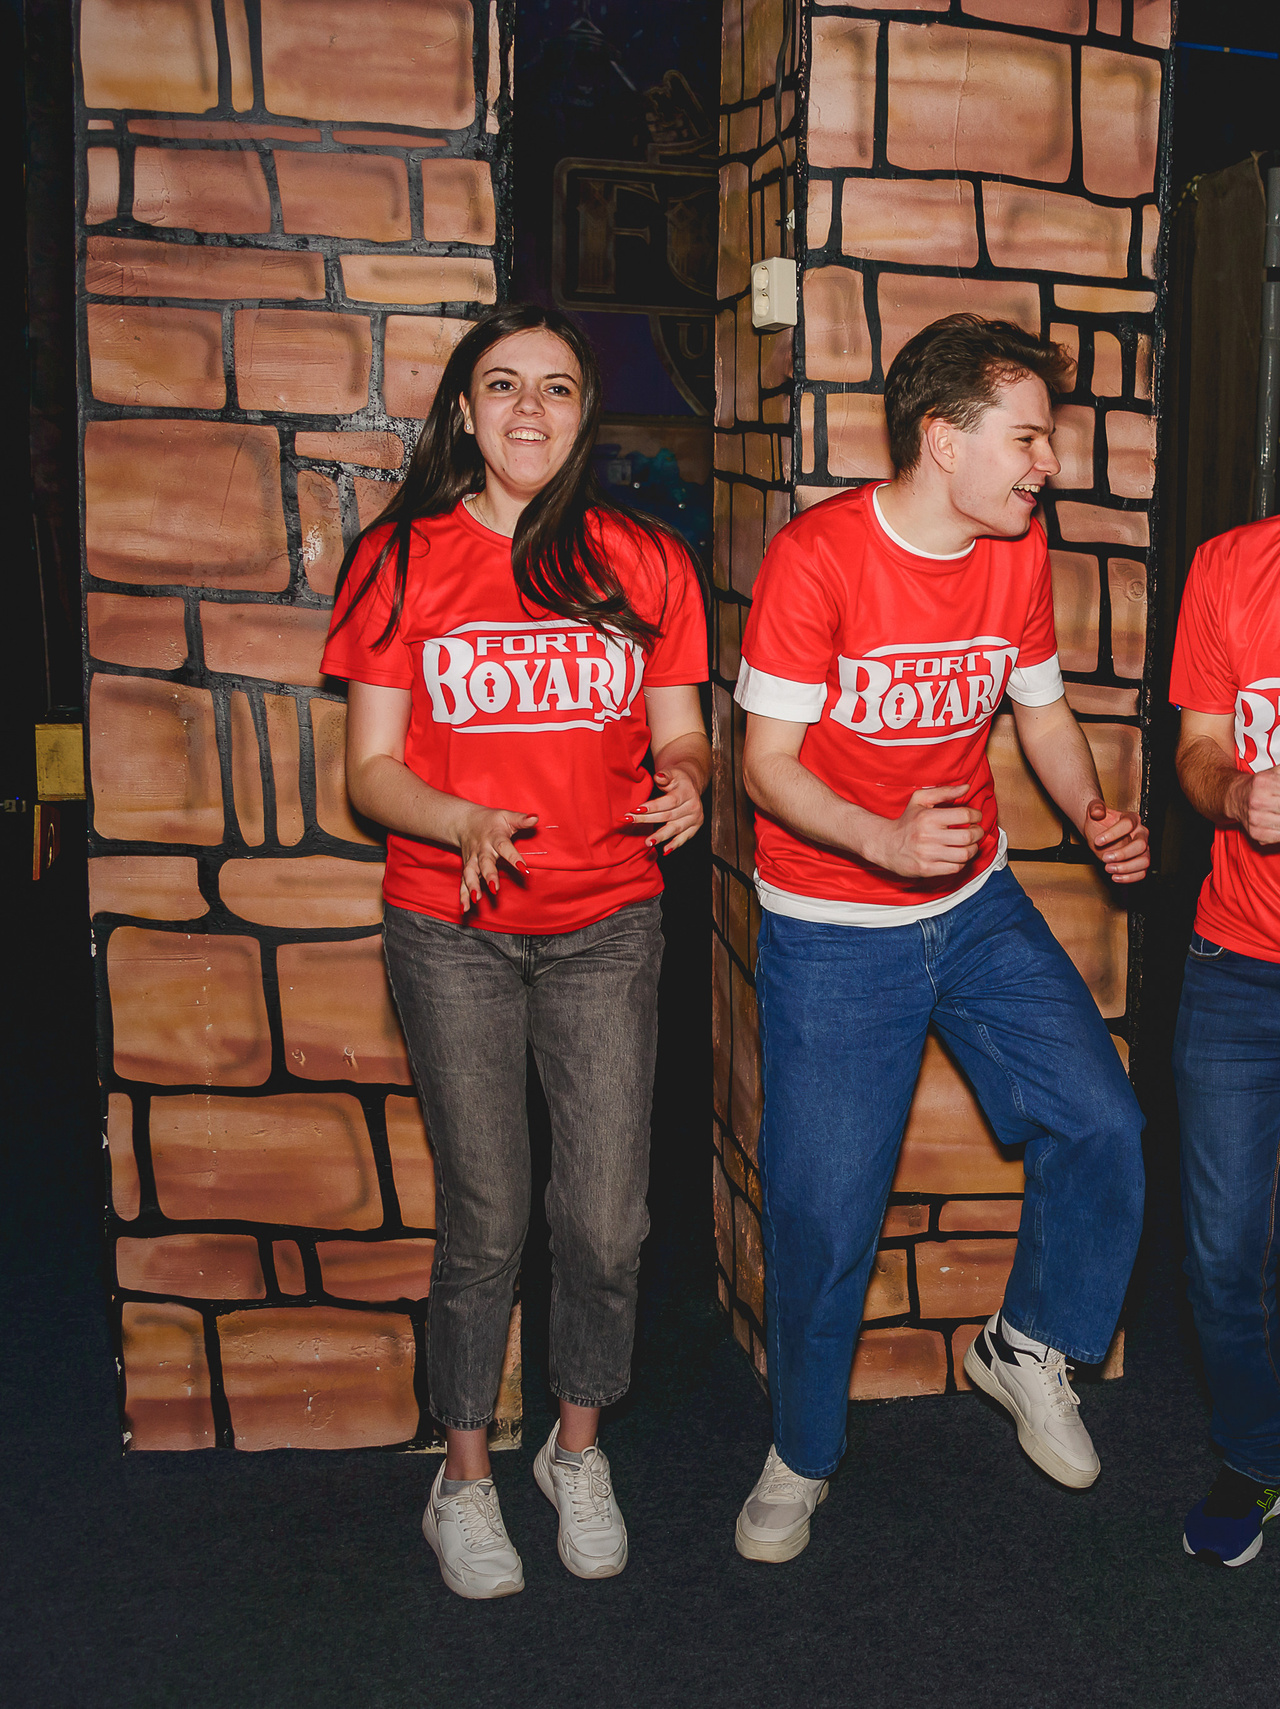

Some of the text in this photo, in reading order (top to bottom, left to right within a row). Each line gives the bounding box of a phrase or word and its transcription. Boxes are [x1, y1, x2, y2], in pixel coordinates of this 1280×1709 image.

[477, 632, 594, 656] FORT
[423, 632, 645, 725] BOYARD
[893, 652, 981, 679] FORT
